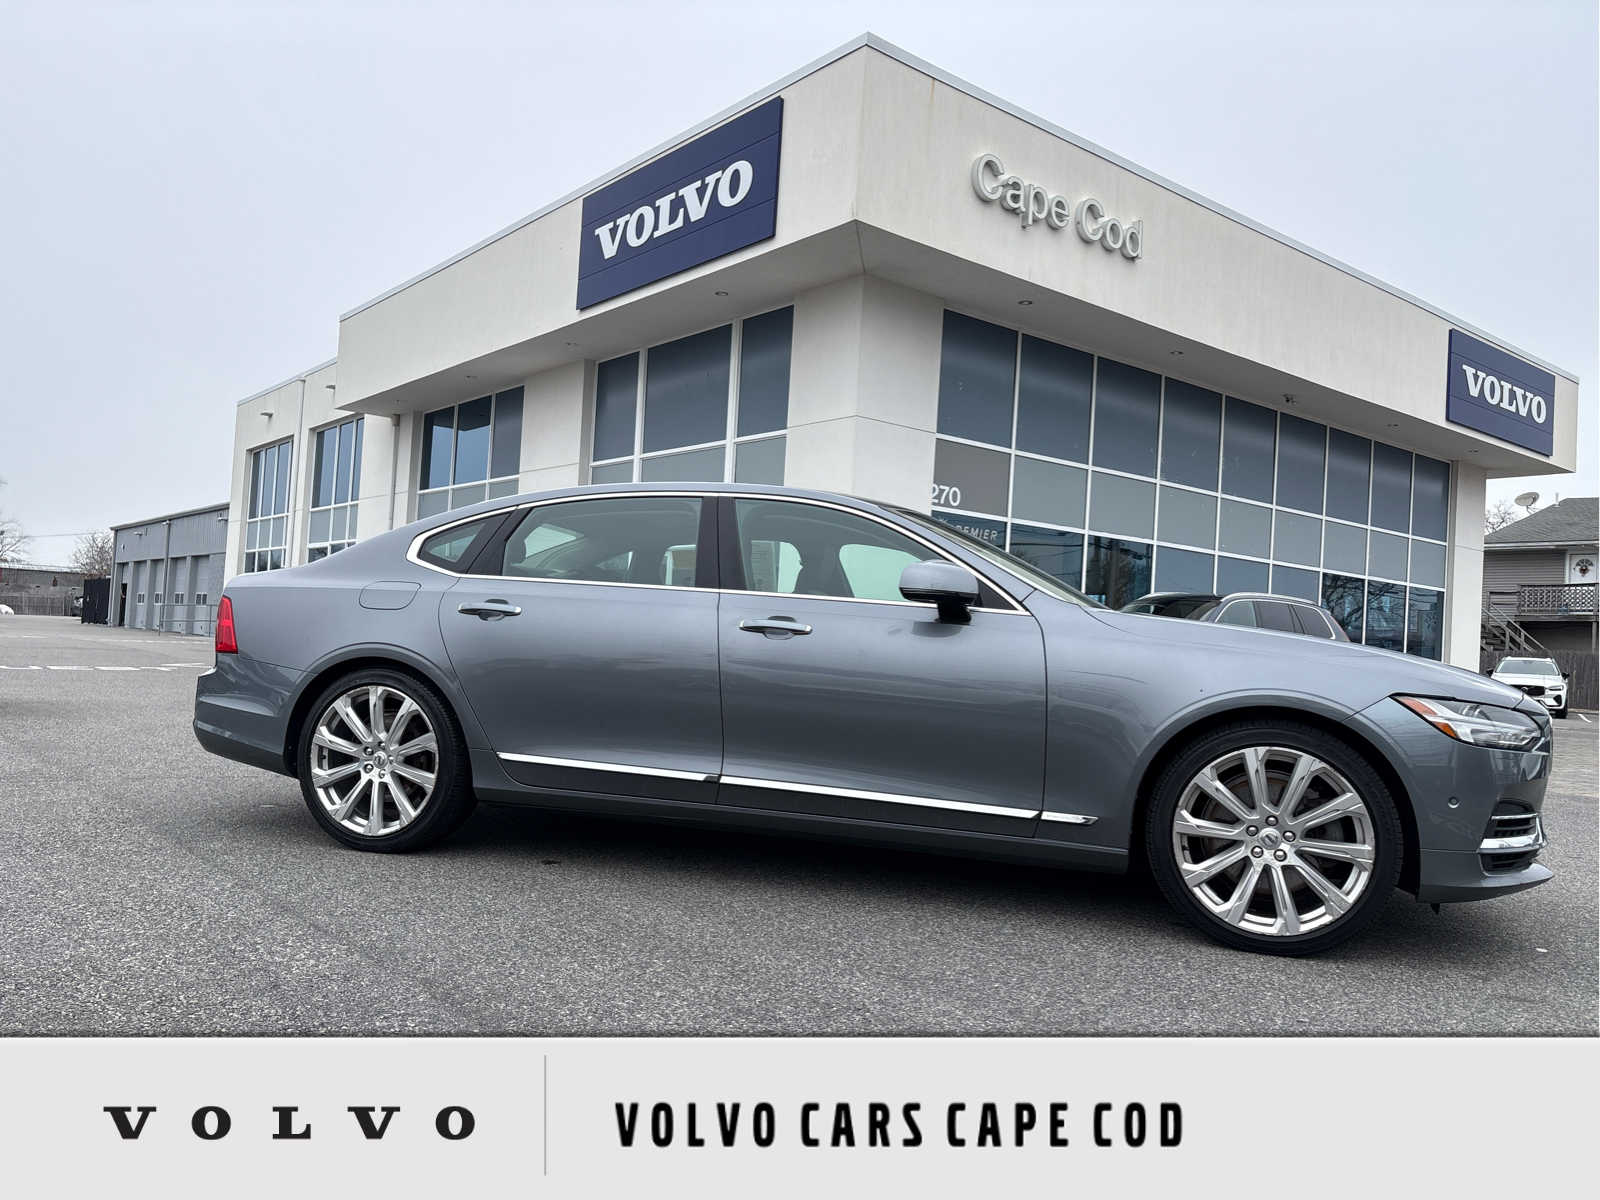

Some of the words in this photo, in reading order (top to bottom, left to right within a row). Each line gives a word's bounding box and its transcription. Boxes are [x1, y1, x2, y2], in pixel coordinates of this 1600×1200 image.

[594, 160, 753, 260] VOLVO
[971, 153, 1072, 230] Cape
[1075, 198, 1144, 262] Cod
[1462, 364, 1547, 424] VOLVO
[931, 483, 961, 507] 270
